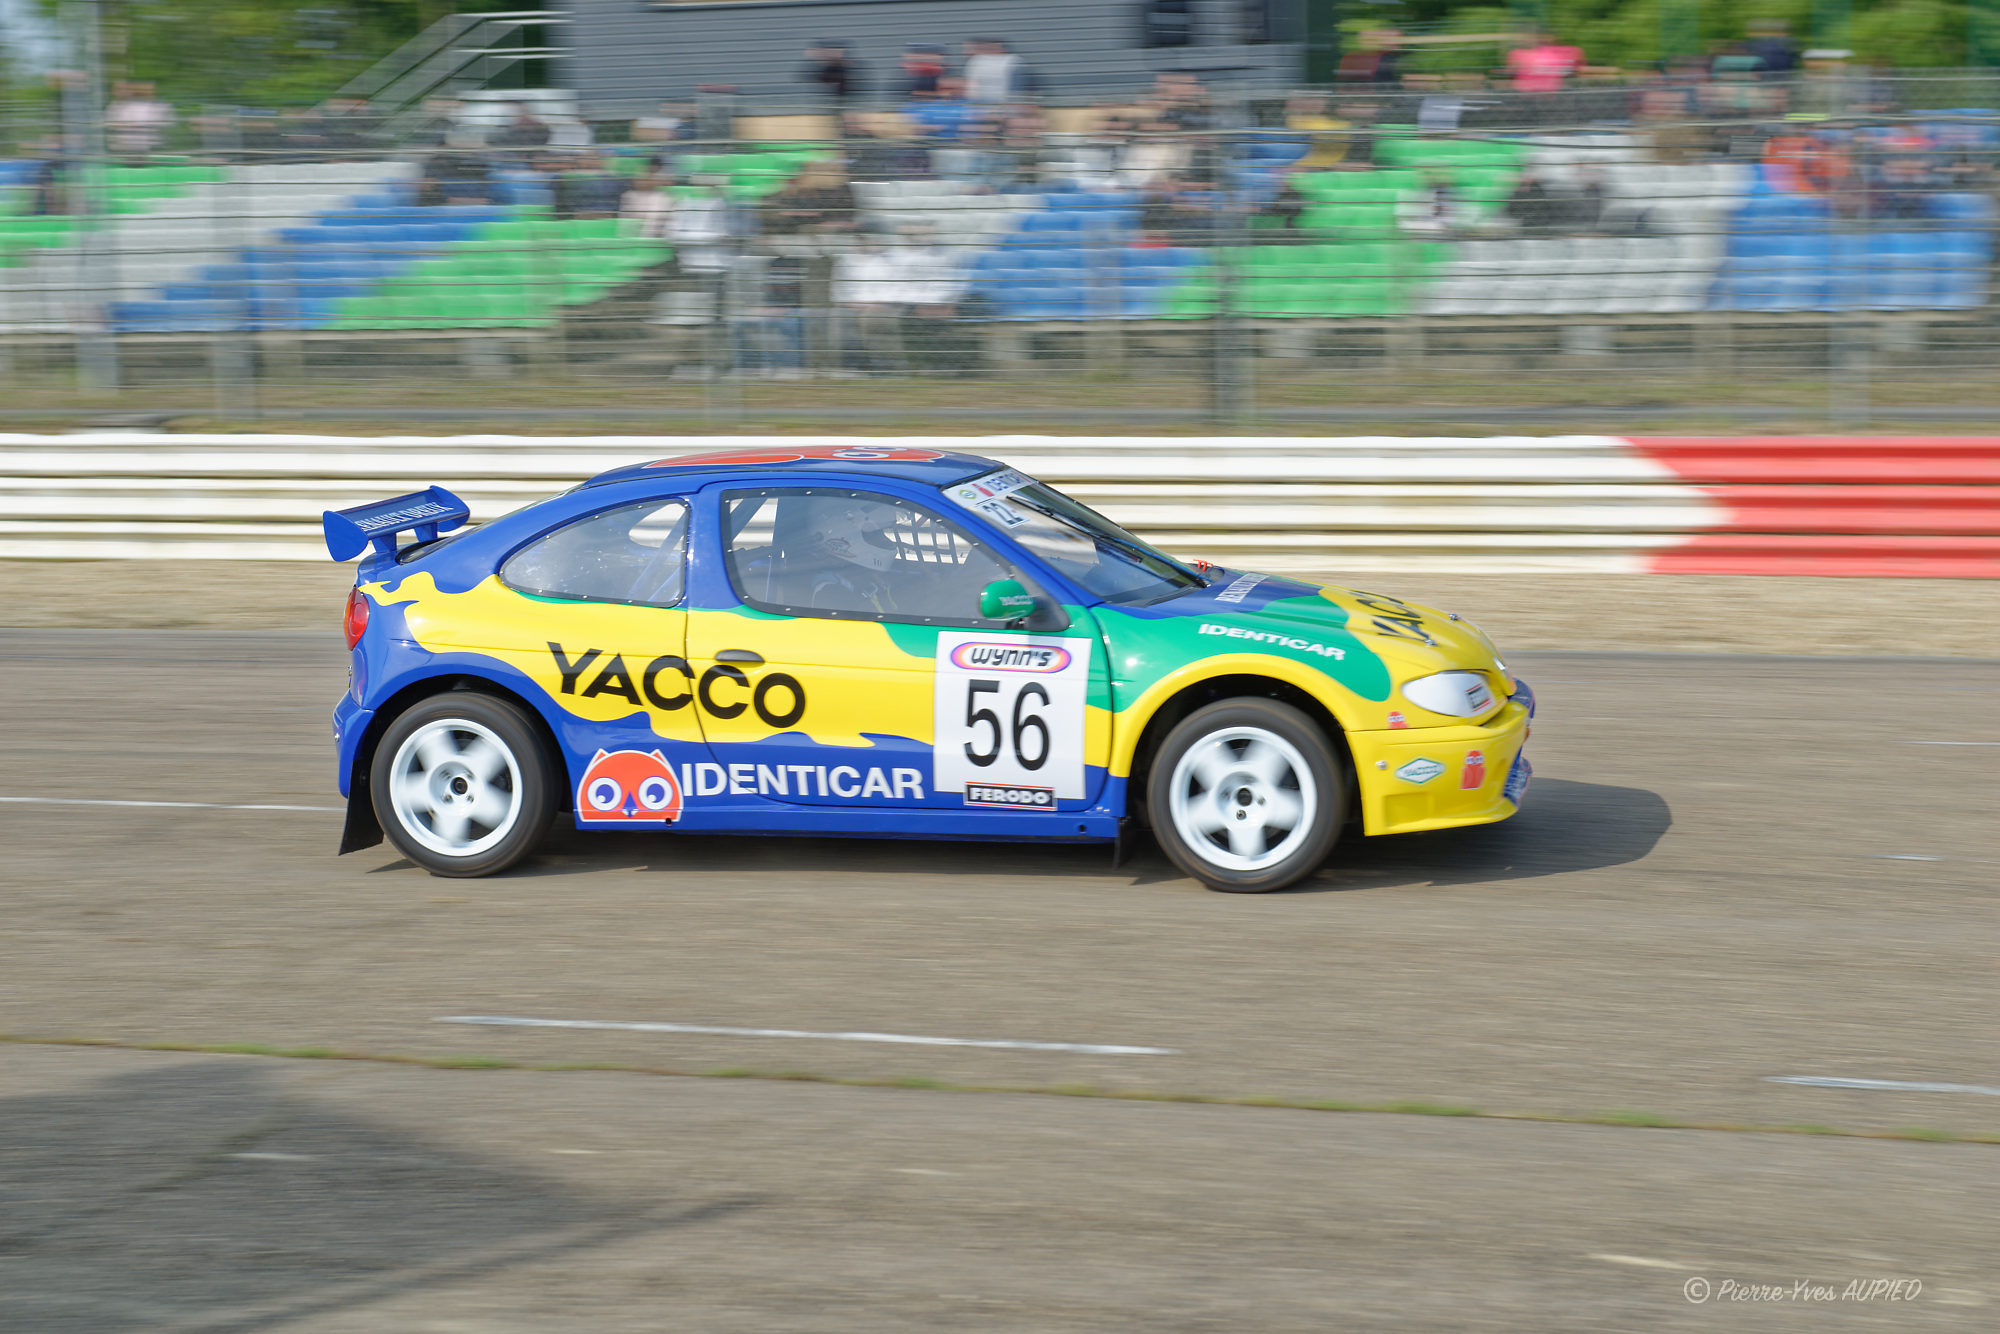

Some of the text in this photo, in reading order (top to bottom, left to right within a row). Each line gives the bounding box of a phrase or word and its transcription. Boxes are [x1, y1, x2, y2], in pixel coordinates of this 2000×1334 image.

[1198, 623, 1346, 661] IDENTICAR
[547, 641, 806, 728] YACCO
[963, 679, 1051, 771] 56
[681, 763, 924, 799] IDENTICAR
[969, 787, 1050, 805] FERODO
